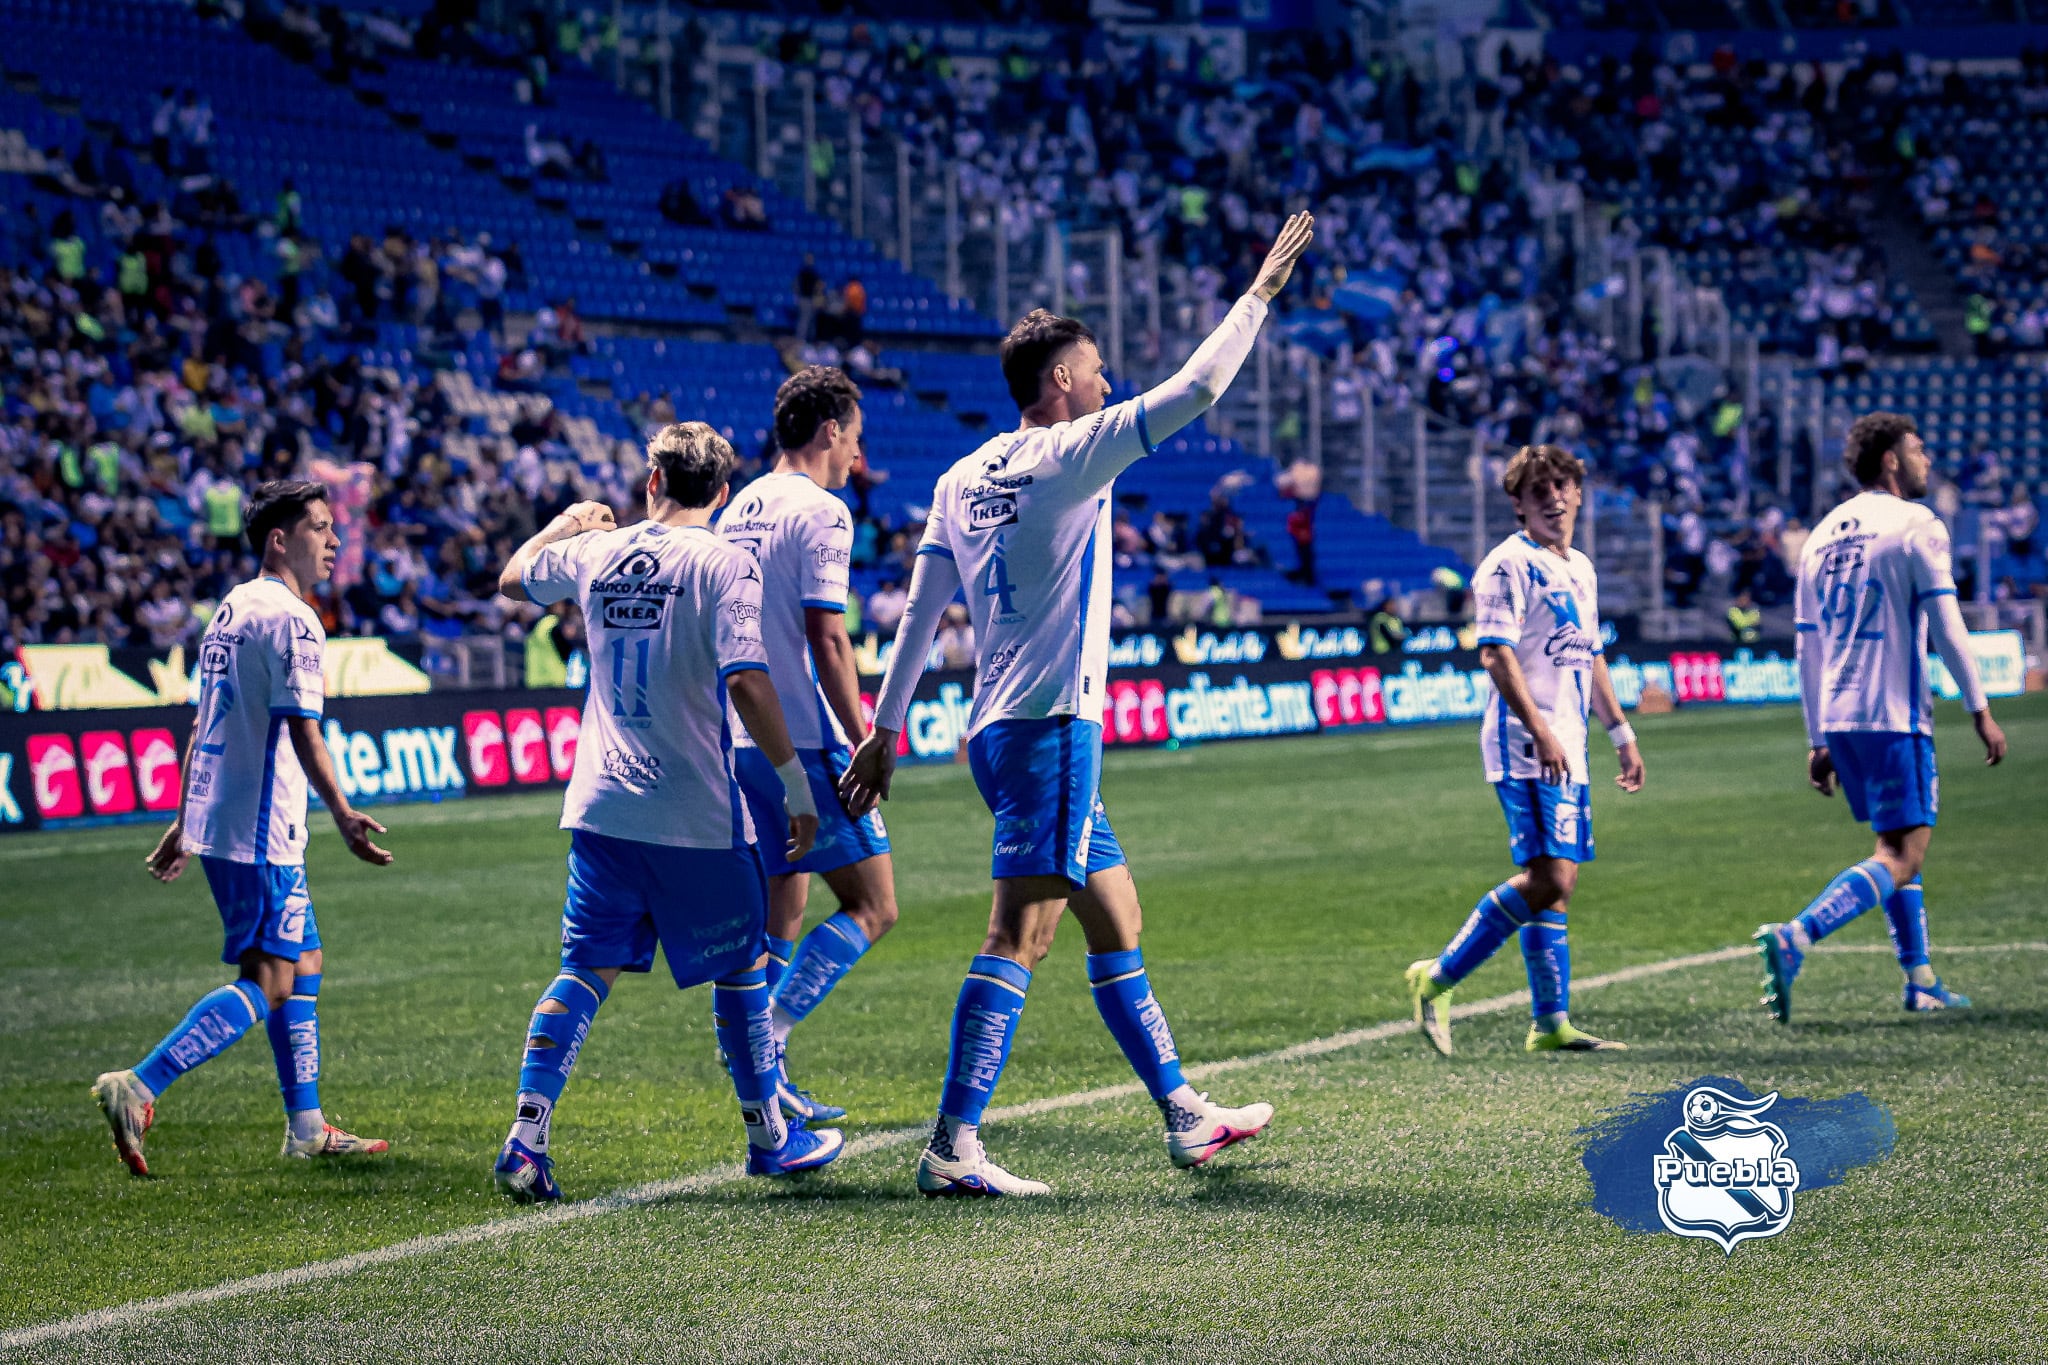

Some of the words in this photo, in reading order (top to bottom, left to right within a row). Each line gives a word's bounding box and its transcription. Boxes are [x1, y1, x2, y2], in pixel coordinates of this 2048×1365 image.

[973, 502, 1014, 521] IKEA
[590, 579, 632, 594] Banco
[634, 582, 685, 597] Azteca
[983, 533, 1018, 614] 4
[608, 606, 659, 620] IKEA
[611, 637, 652, 717] 11
[201, 678, 235, 756] 2
[291, 866, 309, 896] 2
[955, 1006, 1010, 1093] PERDURA
